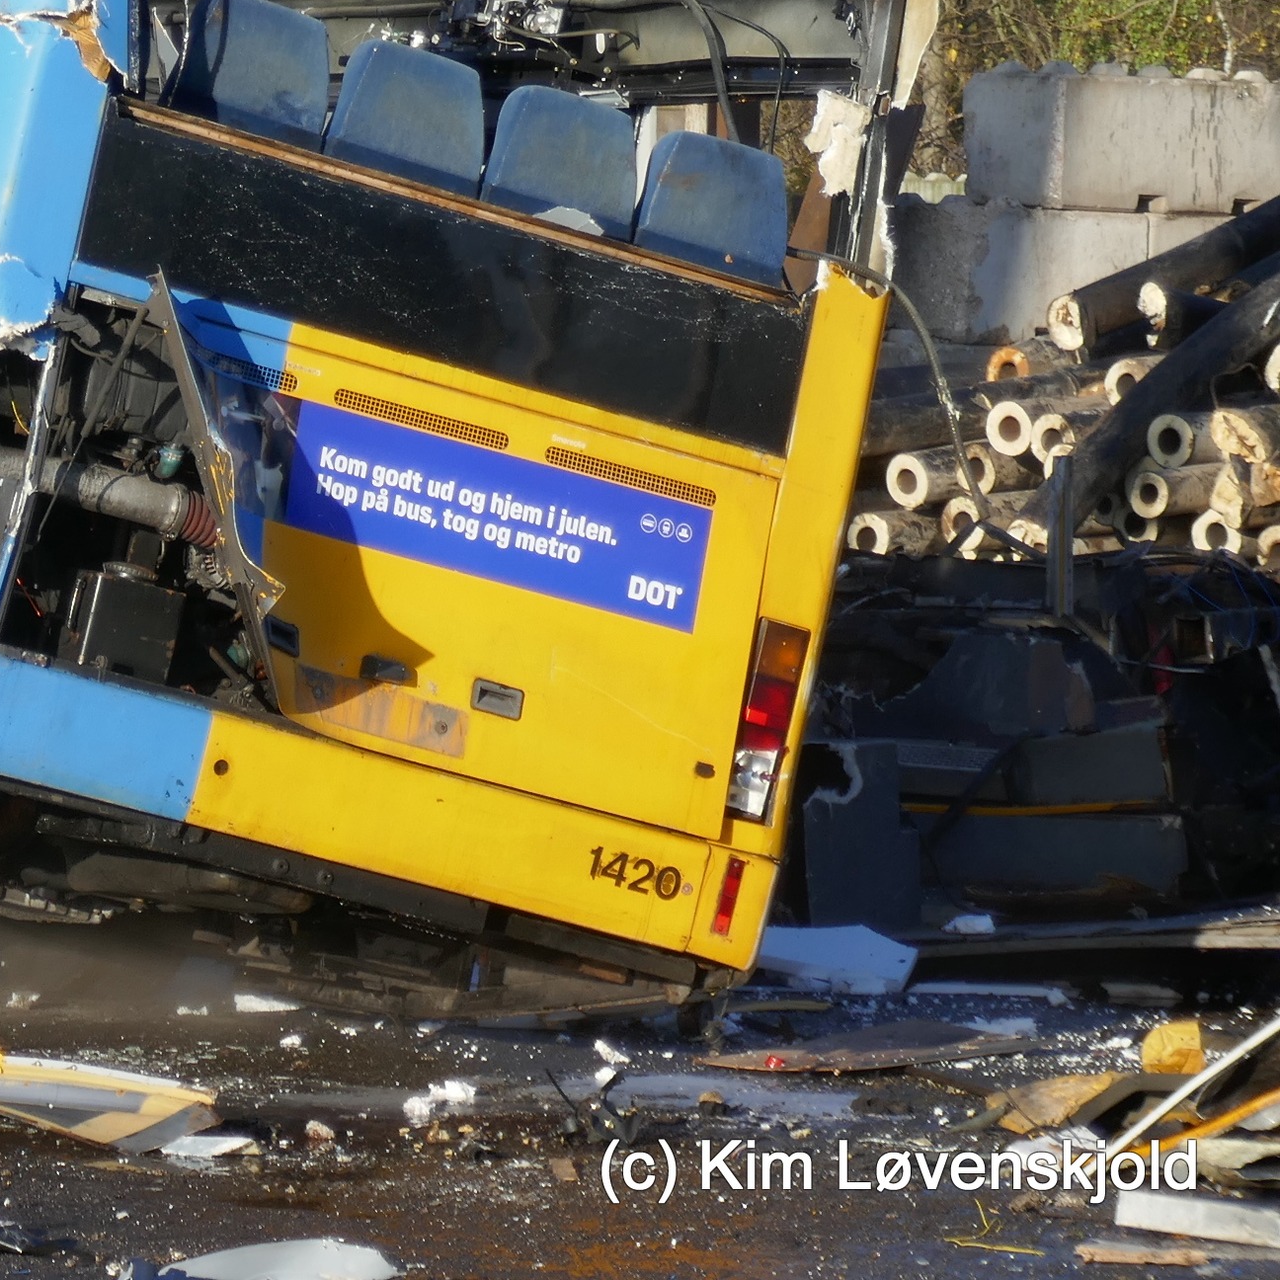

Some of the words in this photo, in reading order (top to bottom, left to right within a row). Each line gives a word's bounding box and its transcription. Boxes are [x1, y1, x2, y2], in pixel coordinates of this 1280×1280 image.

[316, 473, 358, 507] Hop
[361, 488, 389, 513] på
[393, 494, 437, 528] bus,
[442, 508, 480, 540] tog
[483, 523, 512, 549] og
[515, 530, 581, 564] metro
[320, 446, 368, 479] Kom
[372, 464, 423, 494] godt
[427, 479, 455, 502] ud
[458, 488, 486, 514] og
[490, 493, 543, 526] hjem
[546, 506, 556, 529] i
[556, 508, 617, 546] julen.
[627, 574, 684, 610] DOT
[590, 846, 682, 901] 1420
